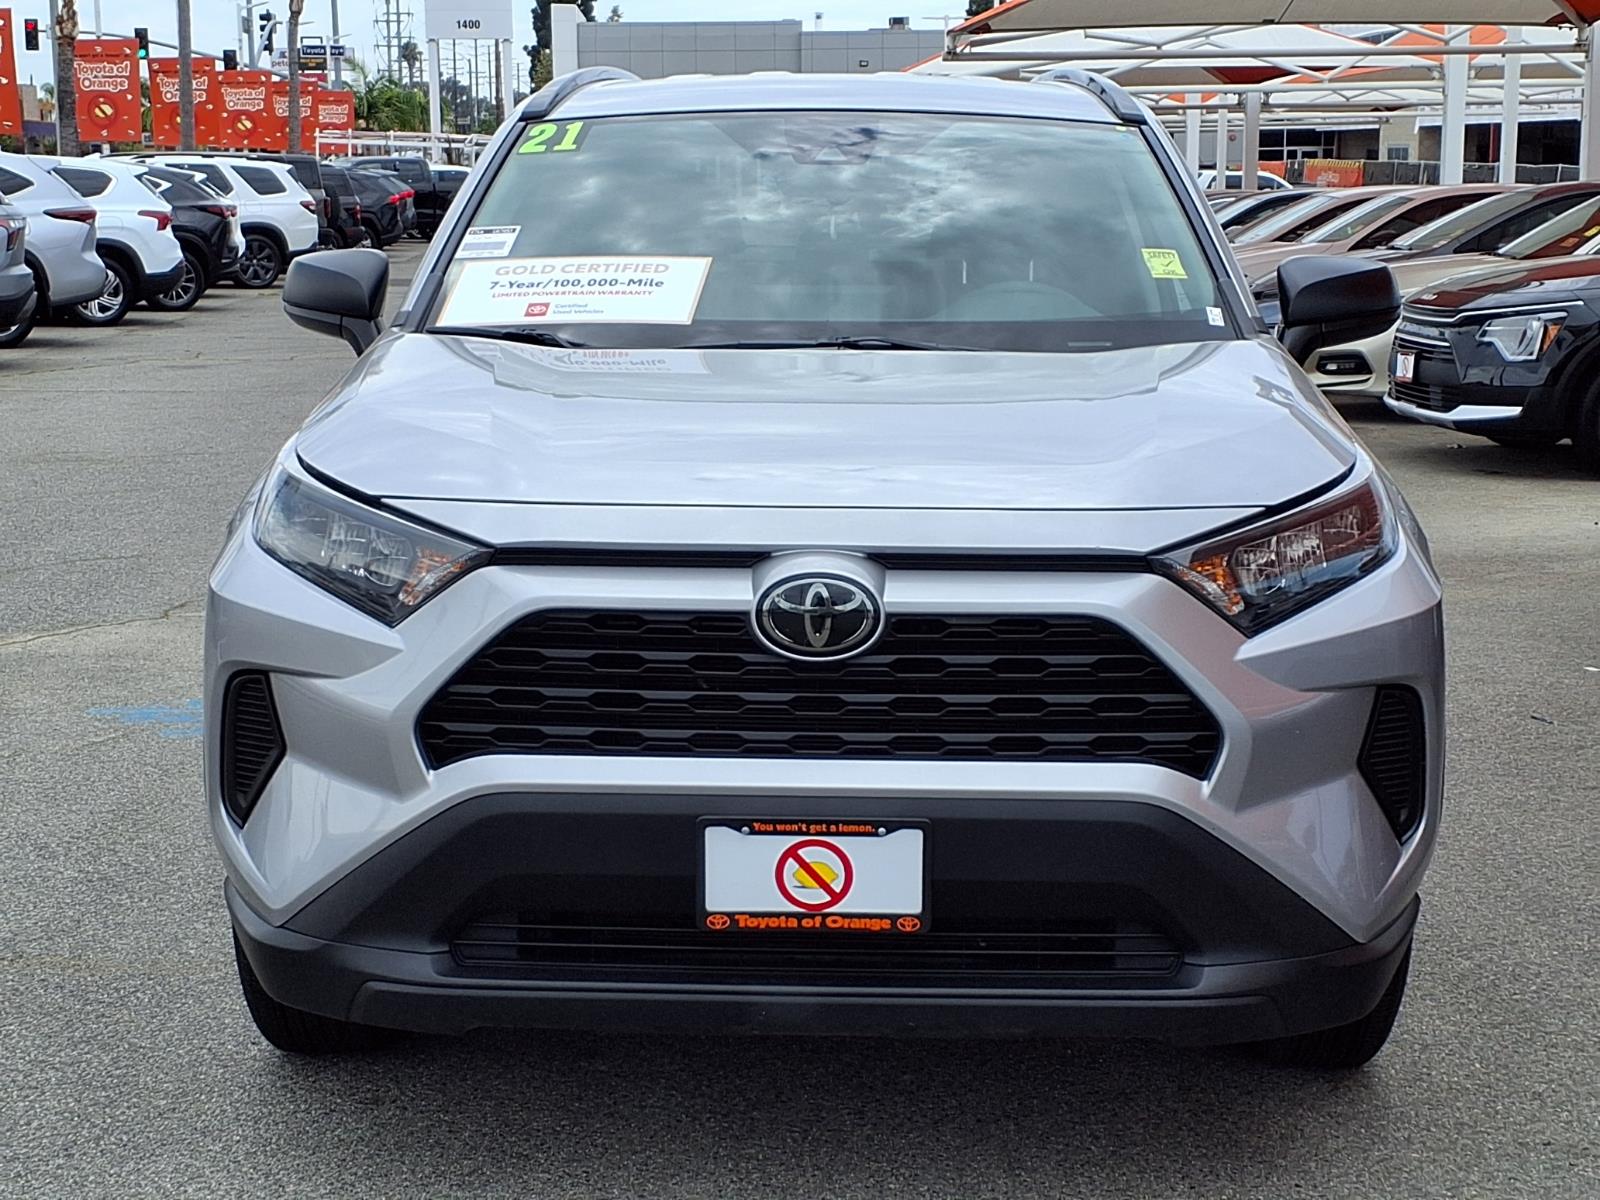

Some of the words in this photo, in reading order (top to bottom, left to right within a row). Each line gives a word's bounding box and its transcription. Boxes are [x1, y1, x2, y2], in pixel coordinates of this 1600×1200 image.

[456, 20, 481, 29] 1400
[75, 62, 115, 76] Toyota
[116, 62, 129, 75] of
[81, 77, 127, 91] Orange
[195, 76, 208, 88] of
[163, 90, 206, 103] Orge
[222, 88, 253, 98] Toyota
[254, 87, 265, 98] of
[227, 99, 263, 110] Orange
[301, 96, 311, 106] of
[319, 105, 340, 113] oyota
[518, 121, 584, 153] 21
[495, 264, 556, 276] GOLD
[560, 263, 670, 274] CERTIFIED
[490, 278, 665, 290] 7-Year/100,000-Mile
[753, 822, 774, 831] You
[775, 822, 807, 832] won't
[809, 823, 827, 833] get
[829, 824, 837, 832] a
[838, 823, 876, 833] lemon.
[735, 915, 798, 929] Toyota
[801, 915, 823, 928] of
[825, 916, 892, 930] Orange
